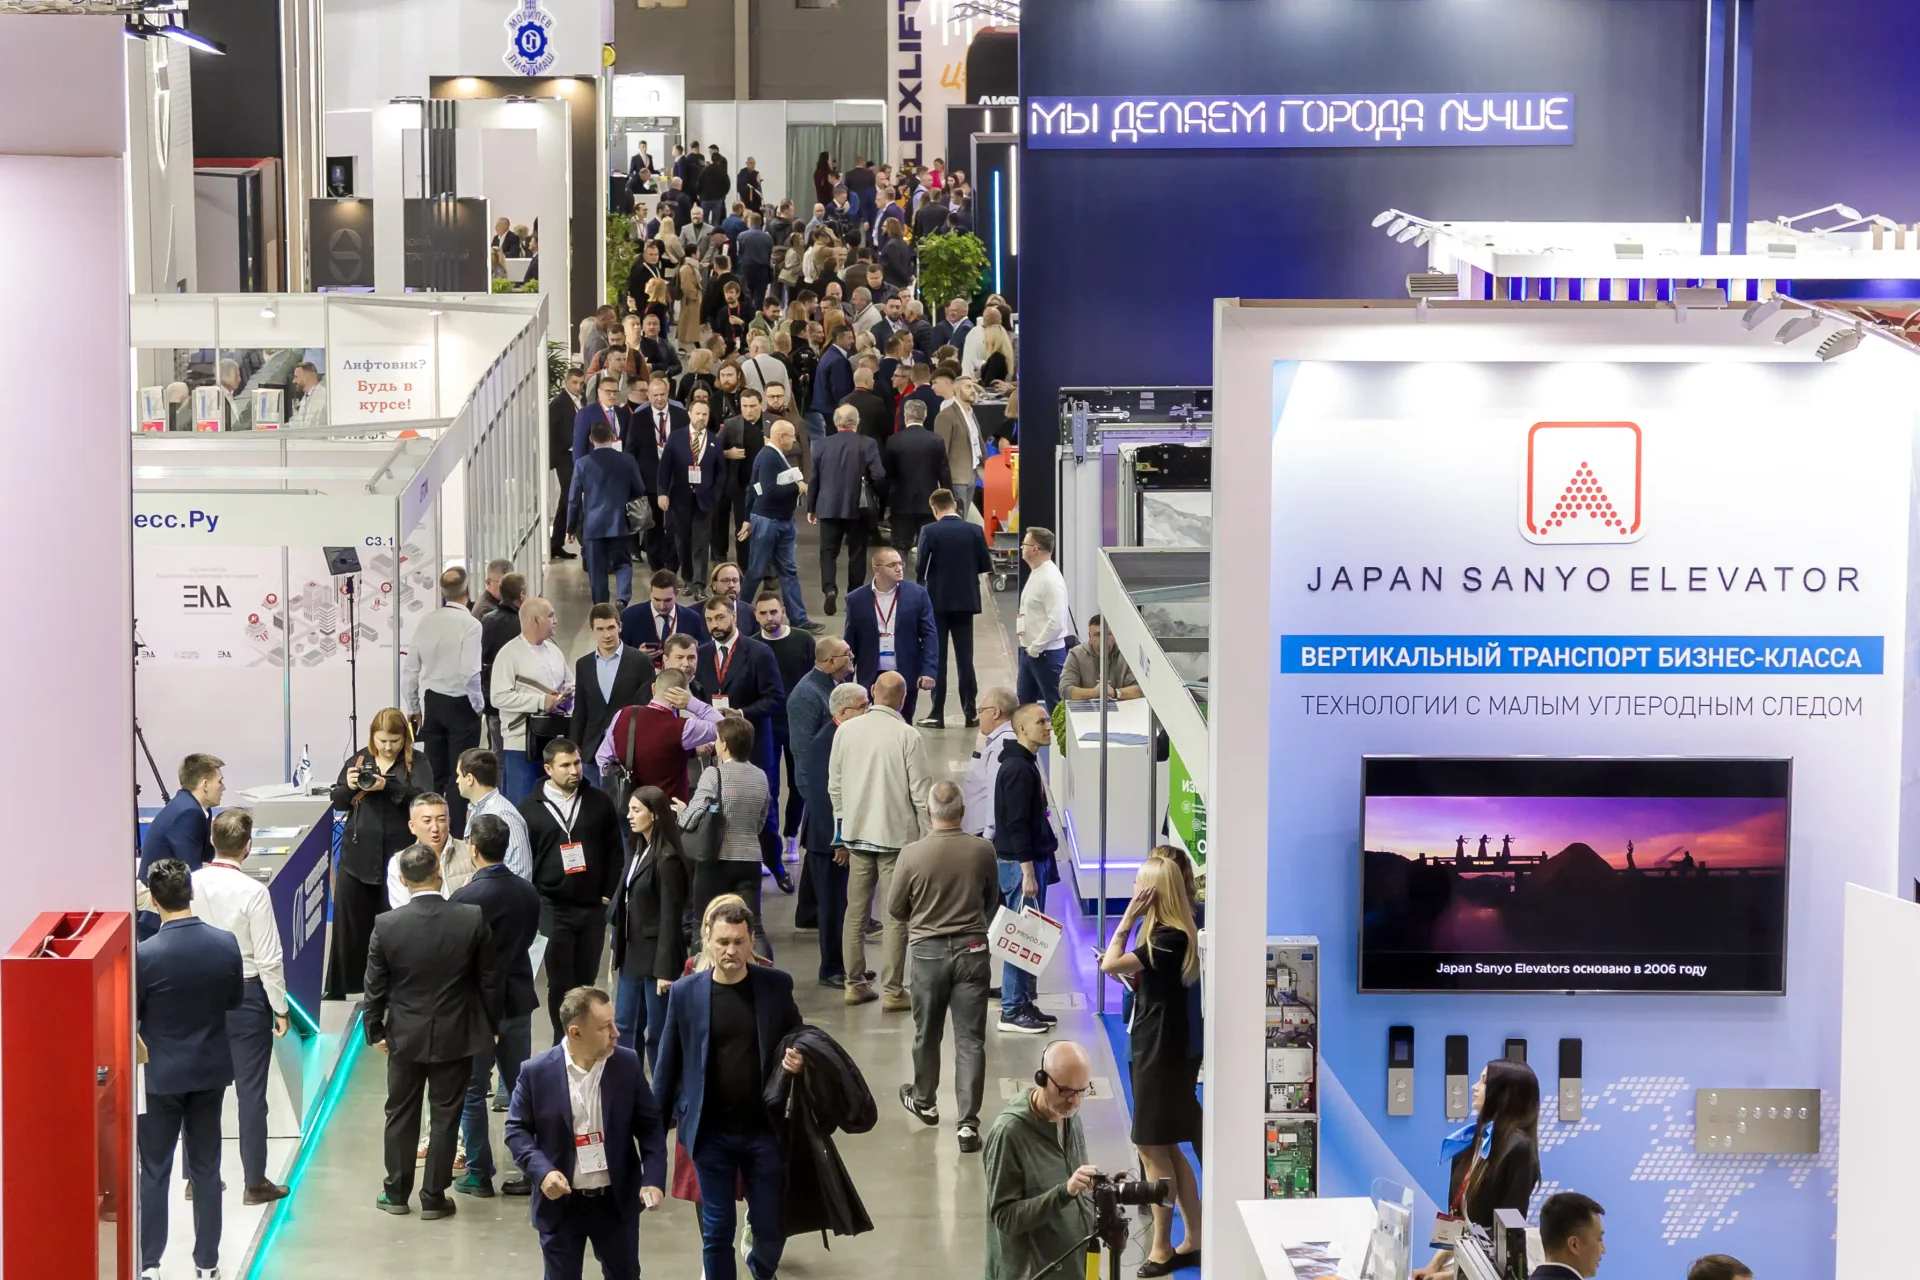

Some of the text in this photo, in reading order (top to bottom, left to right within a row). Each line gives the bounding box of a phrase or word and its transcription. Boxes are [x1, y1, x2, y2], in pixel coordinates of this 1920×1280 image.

[509, 11, 552, 30] МОГИЛЕВ
[508, 52, 555, 75] ЛИФТМАШ
[1031, 98, 1569, 143] МЫ ДЕЛАЕМ ГОРОДА ЛУЧШЕ
[343, 359, 426, 372] Лифтовик?
[357, 380, 413, 394] Будь в
[359, 398, 411, 413] курсе!
[1307, 566, 1860, 593] JAPAN SANYO ELEVATOR
[1301, 642, 1862, 668] ВЕРТИКАЛЬНЫЙ ТРАНСПОРТ БИЗНЕС-КЛАССА
[1301, 696, 1863, 719] ТЕХНОЛОГИИ С МАЛЫМ УГЛЕРОДНЫМ СЛЕДОМ
[1016, 930, 1049, 949] PRIVOD.RU
[1436, 963, 1707, 977] Japan Sanyo Elevators основано в 2006 году
